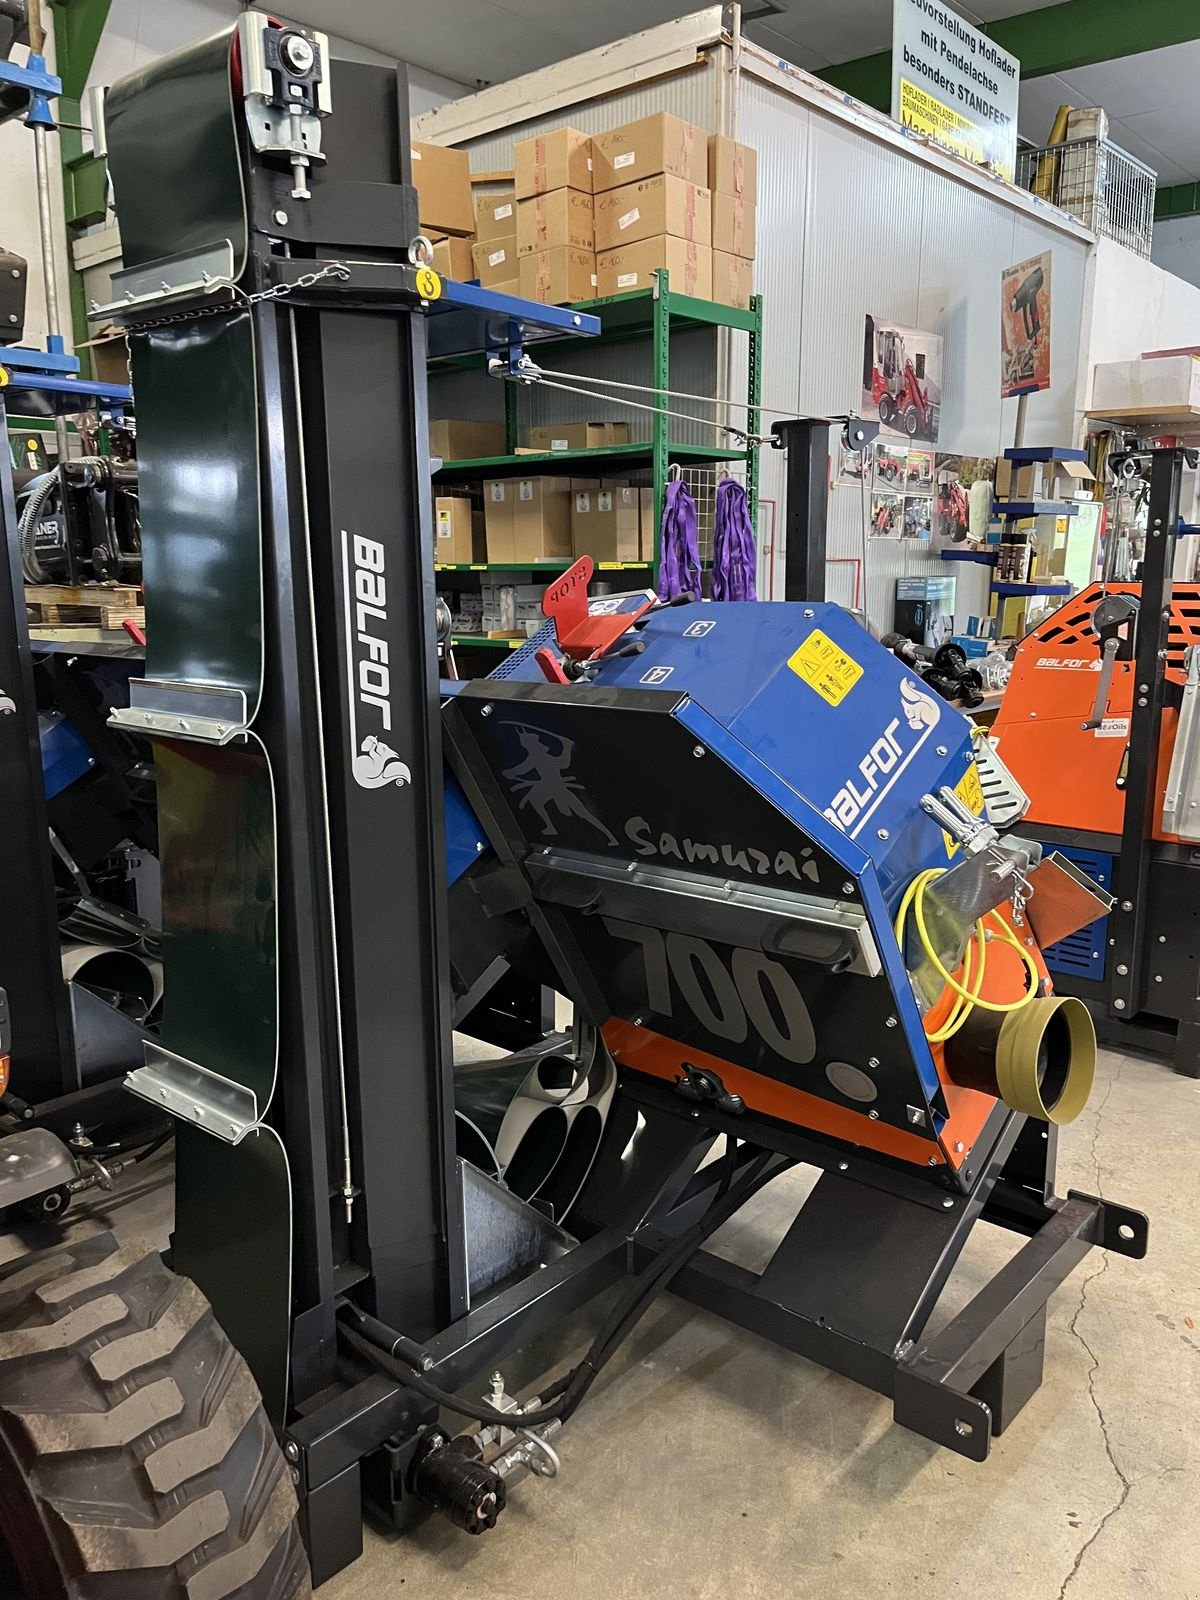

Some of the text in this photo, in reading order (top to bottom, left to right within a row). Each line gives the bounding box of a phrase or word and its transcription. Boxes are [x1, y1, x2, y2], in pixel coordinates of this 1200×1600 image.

[910, 0, 1016, 79] uvorstellung Hoflader
[921, 30, 998, 95] mit Pendelachse
[903, 45, 1011, 126] besonders STANDFEST
[649, 668, 667, 683] 4
[624, 815, 820, 884] Samurai
[602, 916, 817, 1065] 700
